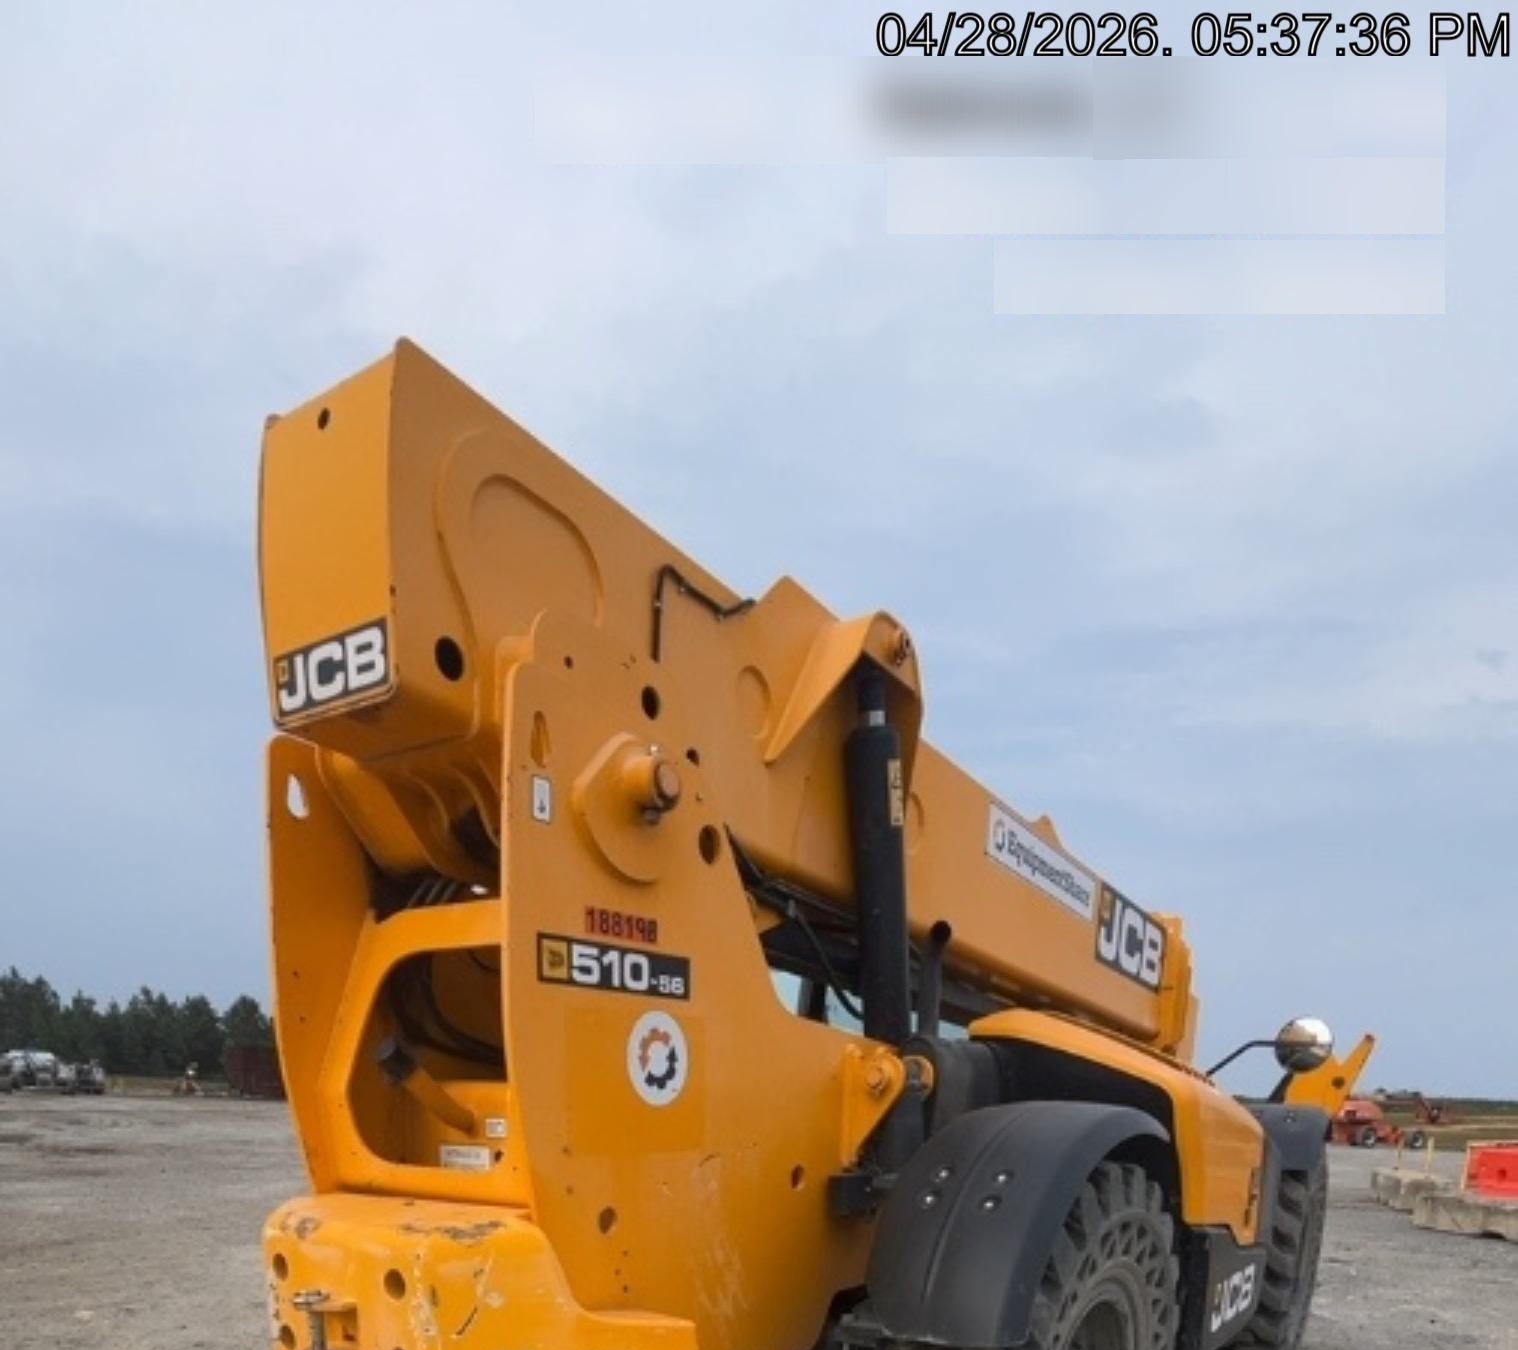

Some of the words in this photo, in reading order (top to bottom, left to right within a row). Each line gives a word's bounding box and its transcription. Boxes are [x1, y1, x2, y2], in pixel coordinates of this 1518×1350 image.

[278, 626, 386, 712] JCB
[1007, 828, 1090, 907] EquipmentS
[1099, 897, 1163, 985] JCB
[1210, 1263, 1256, 1333] JCB
